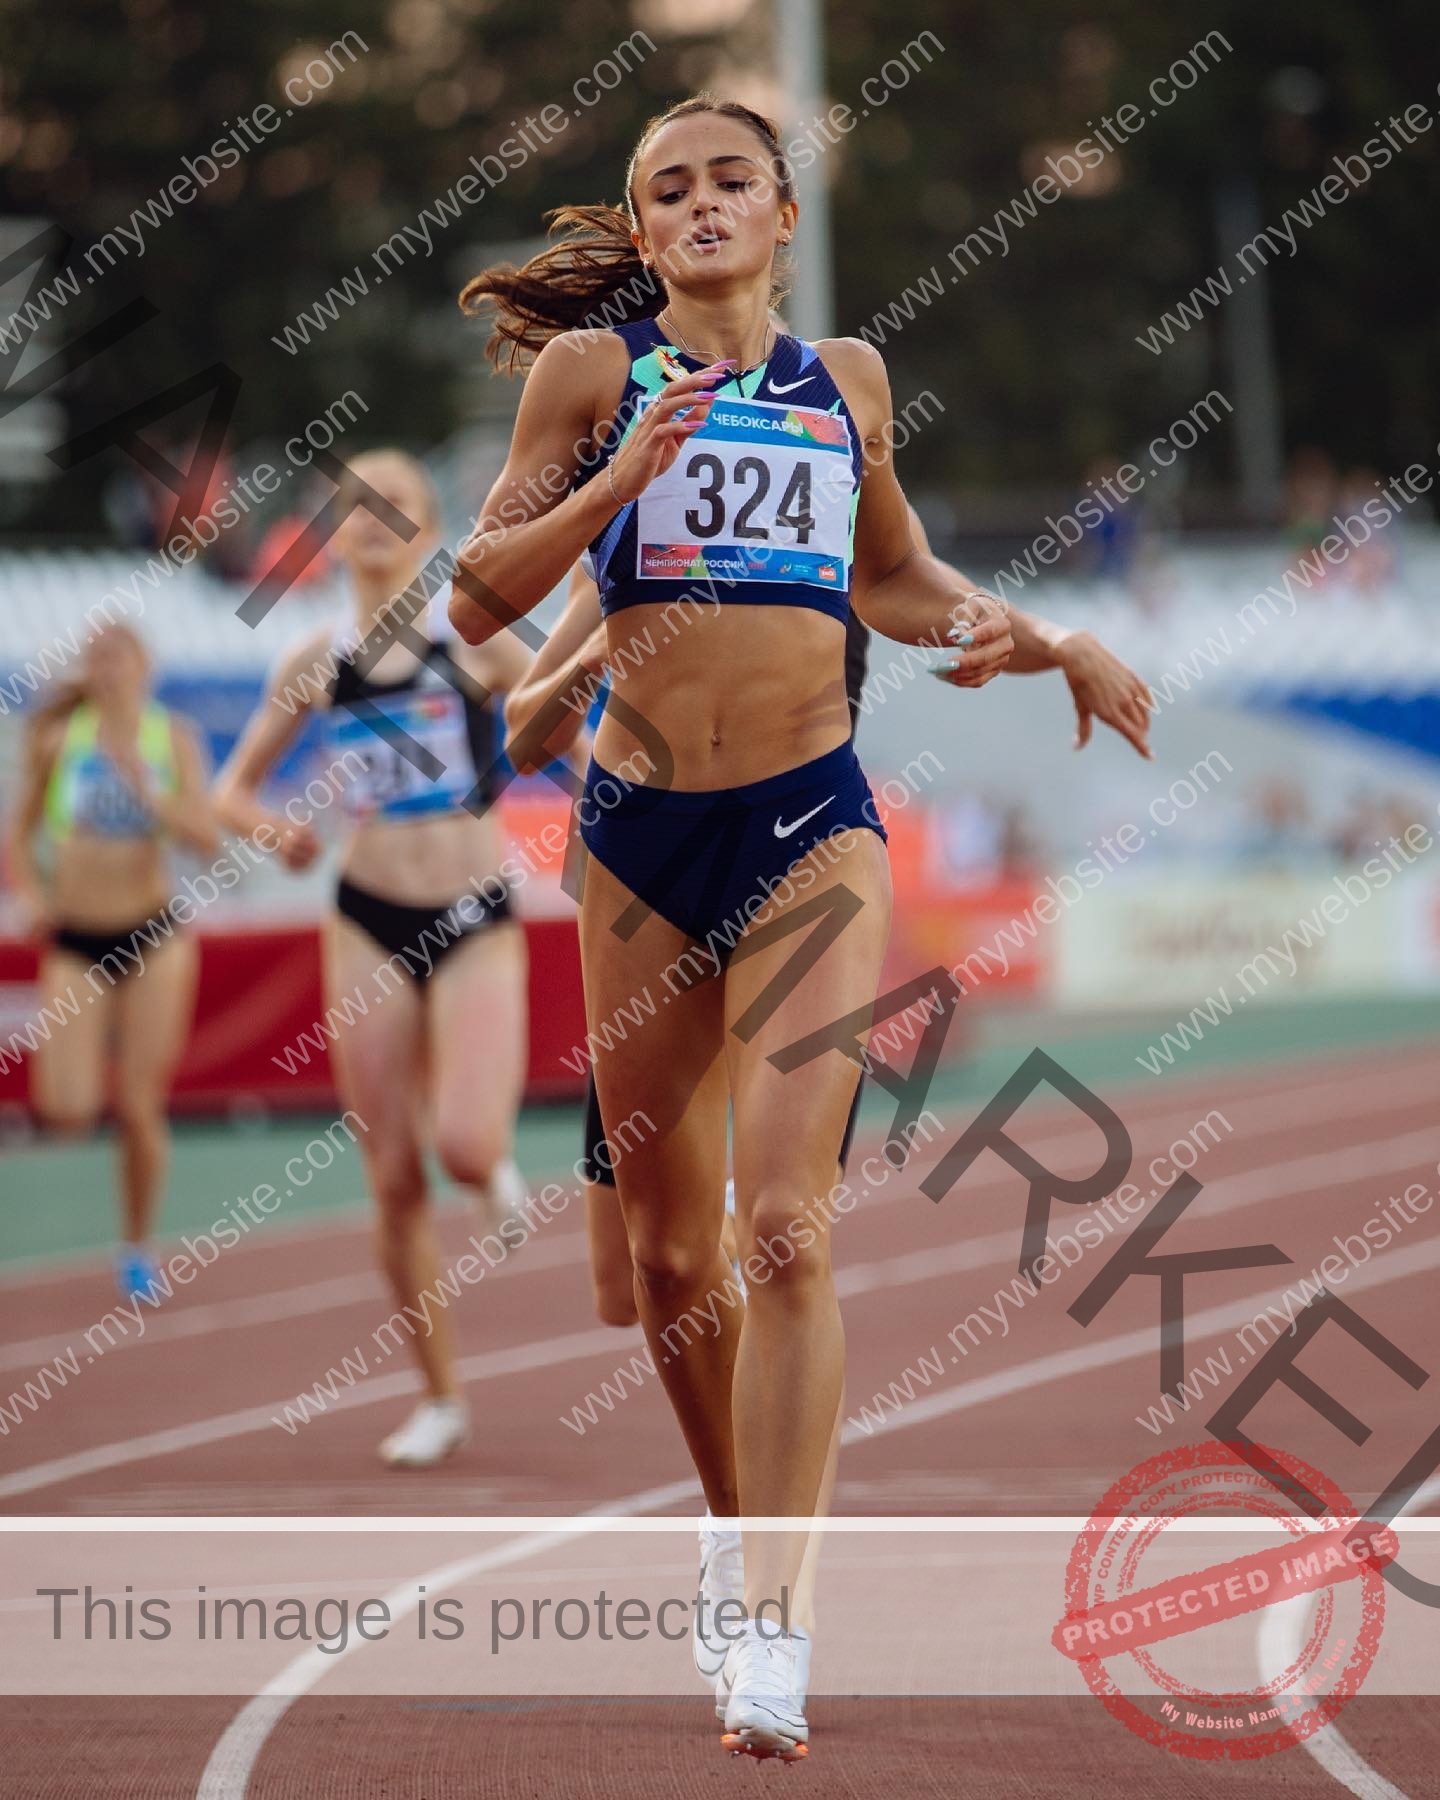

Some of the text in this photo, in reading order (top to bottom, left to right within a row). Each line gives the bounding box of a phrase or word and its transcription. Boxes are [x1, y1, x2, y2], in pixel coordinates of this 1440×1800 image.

[712, 412, 804, 434] ЧЕБОКСАРЫ
[685, 453, 816, 544] 324
[645, 558, 702, 568] ЧЕМПИОНАТ
[703, 559, 744, 570] РОССИИ
